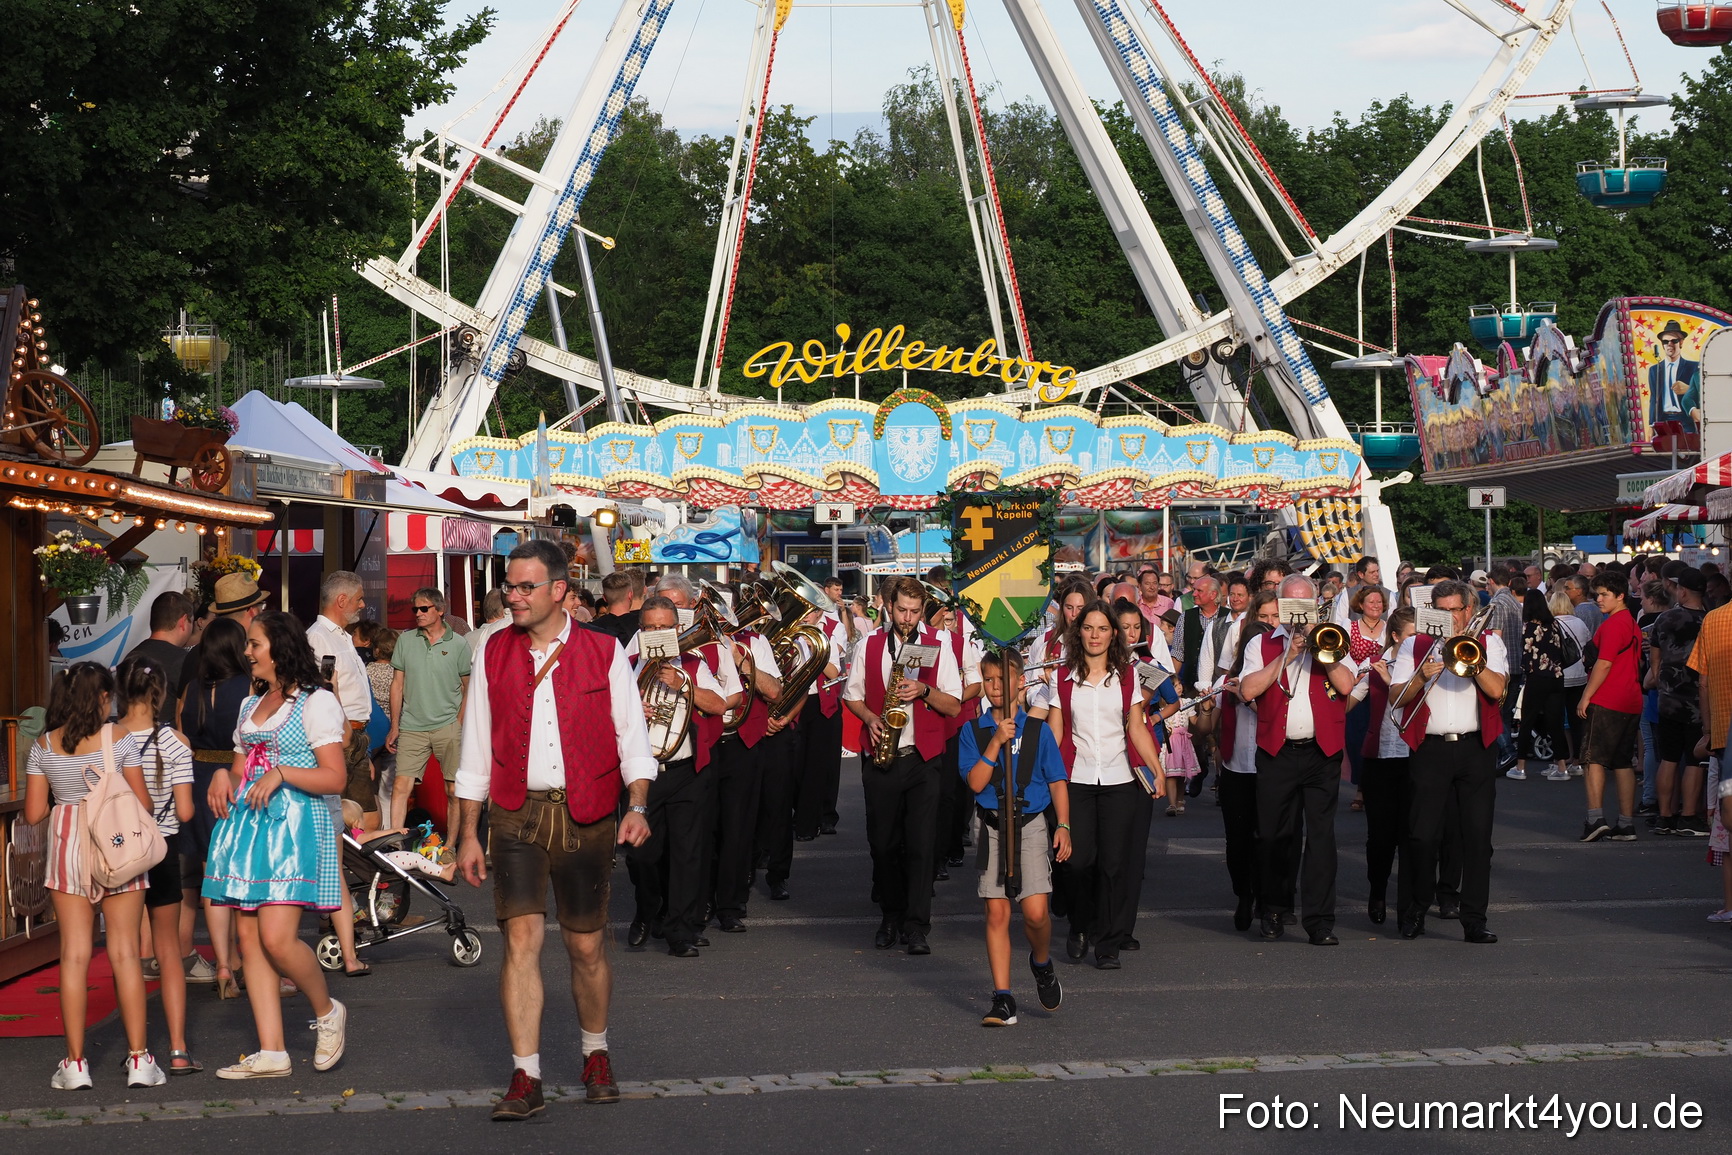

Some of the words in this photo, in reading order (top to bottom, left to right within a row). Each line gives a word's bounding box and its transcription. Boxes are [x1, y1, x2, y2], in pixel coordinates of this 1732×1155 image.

[743, 323, 1076, 402] Willenborg
[996, 501, 1040, 510] Wrkvolk
[996, 510, 1033, 520] Kapelle
[966, 550, 1009, 580] Neumarkt
